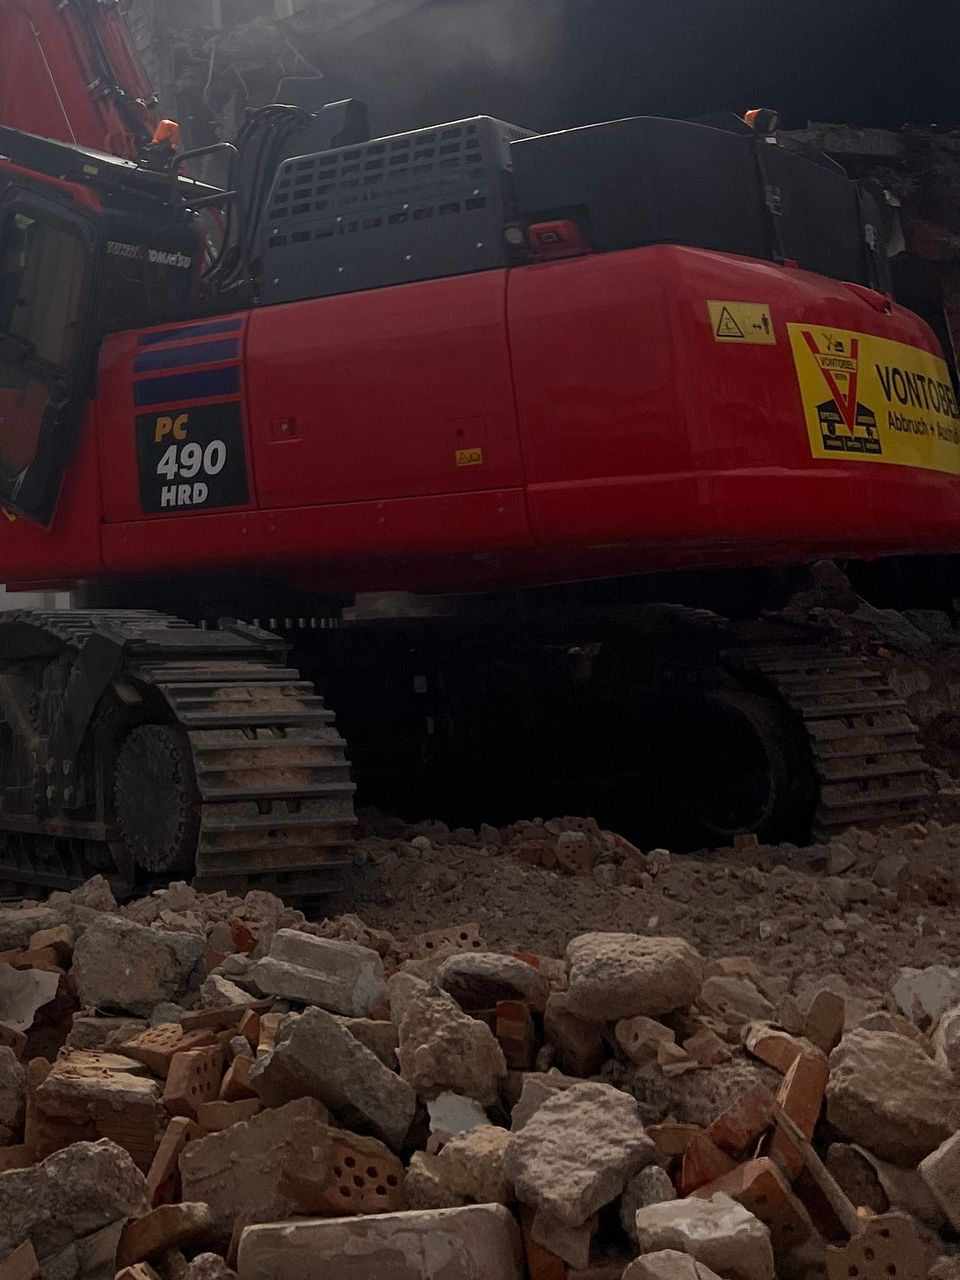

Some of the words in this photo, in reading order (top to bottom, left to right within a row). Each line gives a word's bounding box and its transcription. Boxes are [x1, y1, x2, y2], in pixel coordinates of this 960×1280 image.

[820, 356, 855, 371] VONTOBEL
[154, 414, 189, 442] PC
[888, 410, 929, 436] Abbruch
[156, 440, 227, 480] 490
[160, 482, 209, 507] HRD
